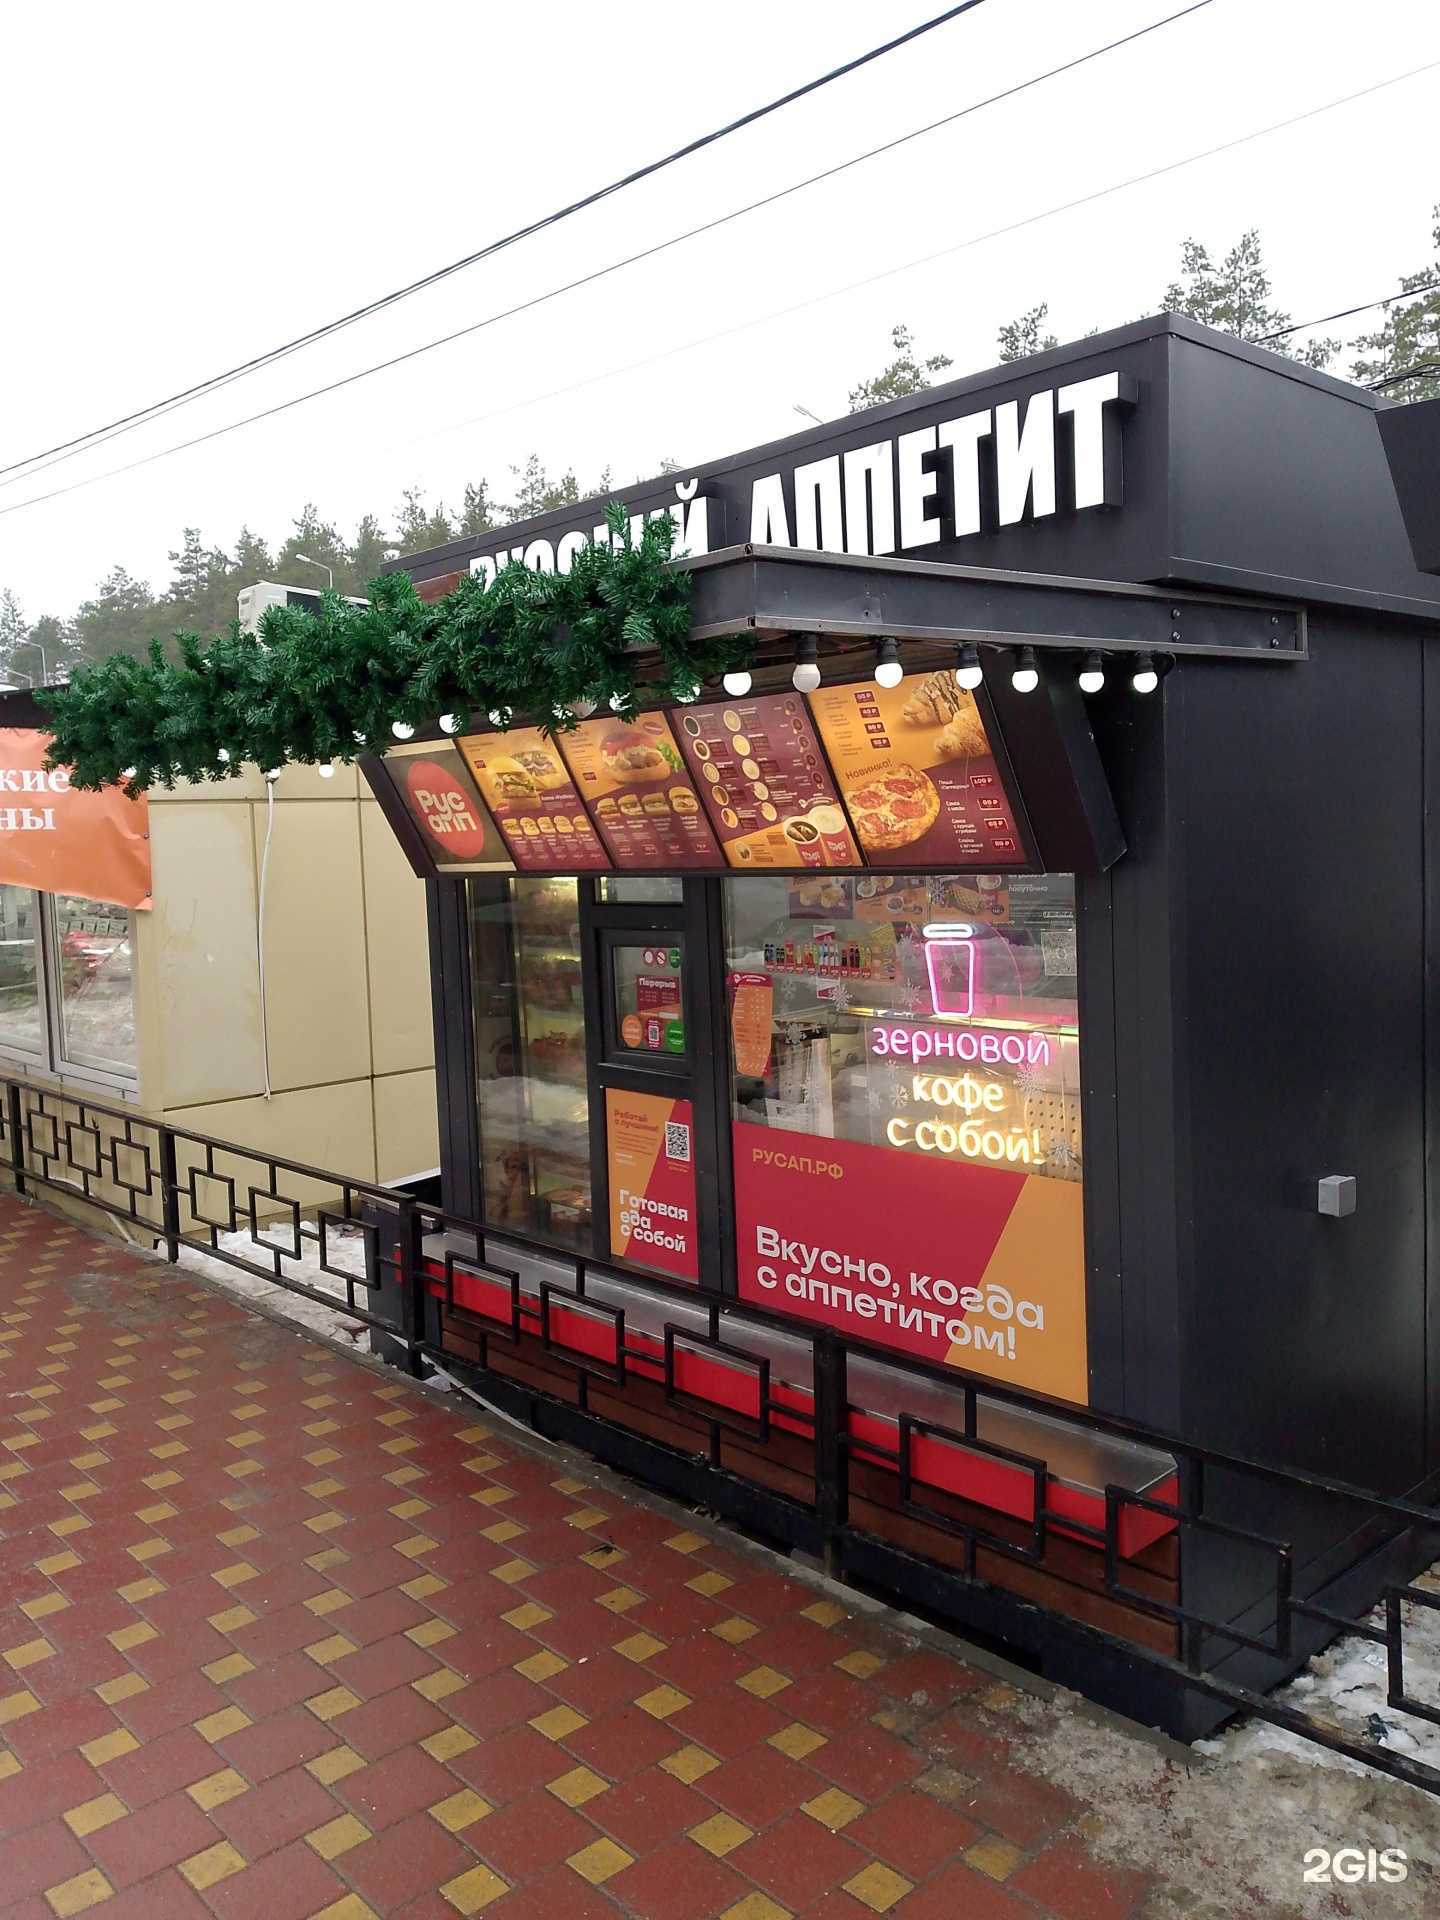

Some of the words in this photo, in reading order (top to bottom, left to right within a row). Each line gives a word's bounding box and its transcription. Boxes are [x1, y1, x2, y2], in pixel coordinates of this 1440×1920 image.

[750, 371, 1120, 556] АППЕТИТ
[845, 758, 894, 780] Новинка!
[871, 1027, 1051, 1066] зерновой
[911, 1072, 1005, 1114] кофе
[886, 1118, 909, 1147] с
[914, 1118, 1043, 1166] собой!
[752, 1147, 845, 1181] РУСАП.РФ
[619, 1188, 689, 1222] Готовая
[619, 1206, 652, 1231] еда
[619, 1223, 631, 1238] с
[632, 1226, 687, 1254] собой
[755, 1224, 902, 1298] Вкусно,
[909, 1271, 1046, 1331] когда
[756, 1264, 778, 1290] с
[784, 1273, 1017, 1361] аппетитом!
